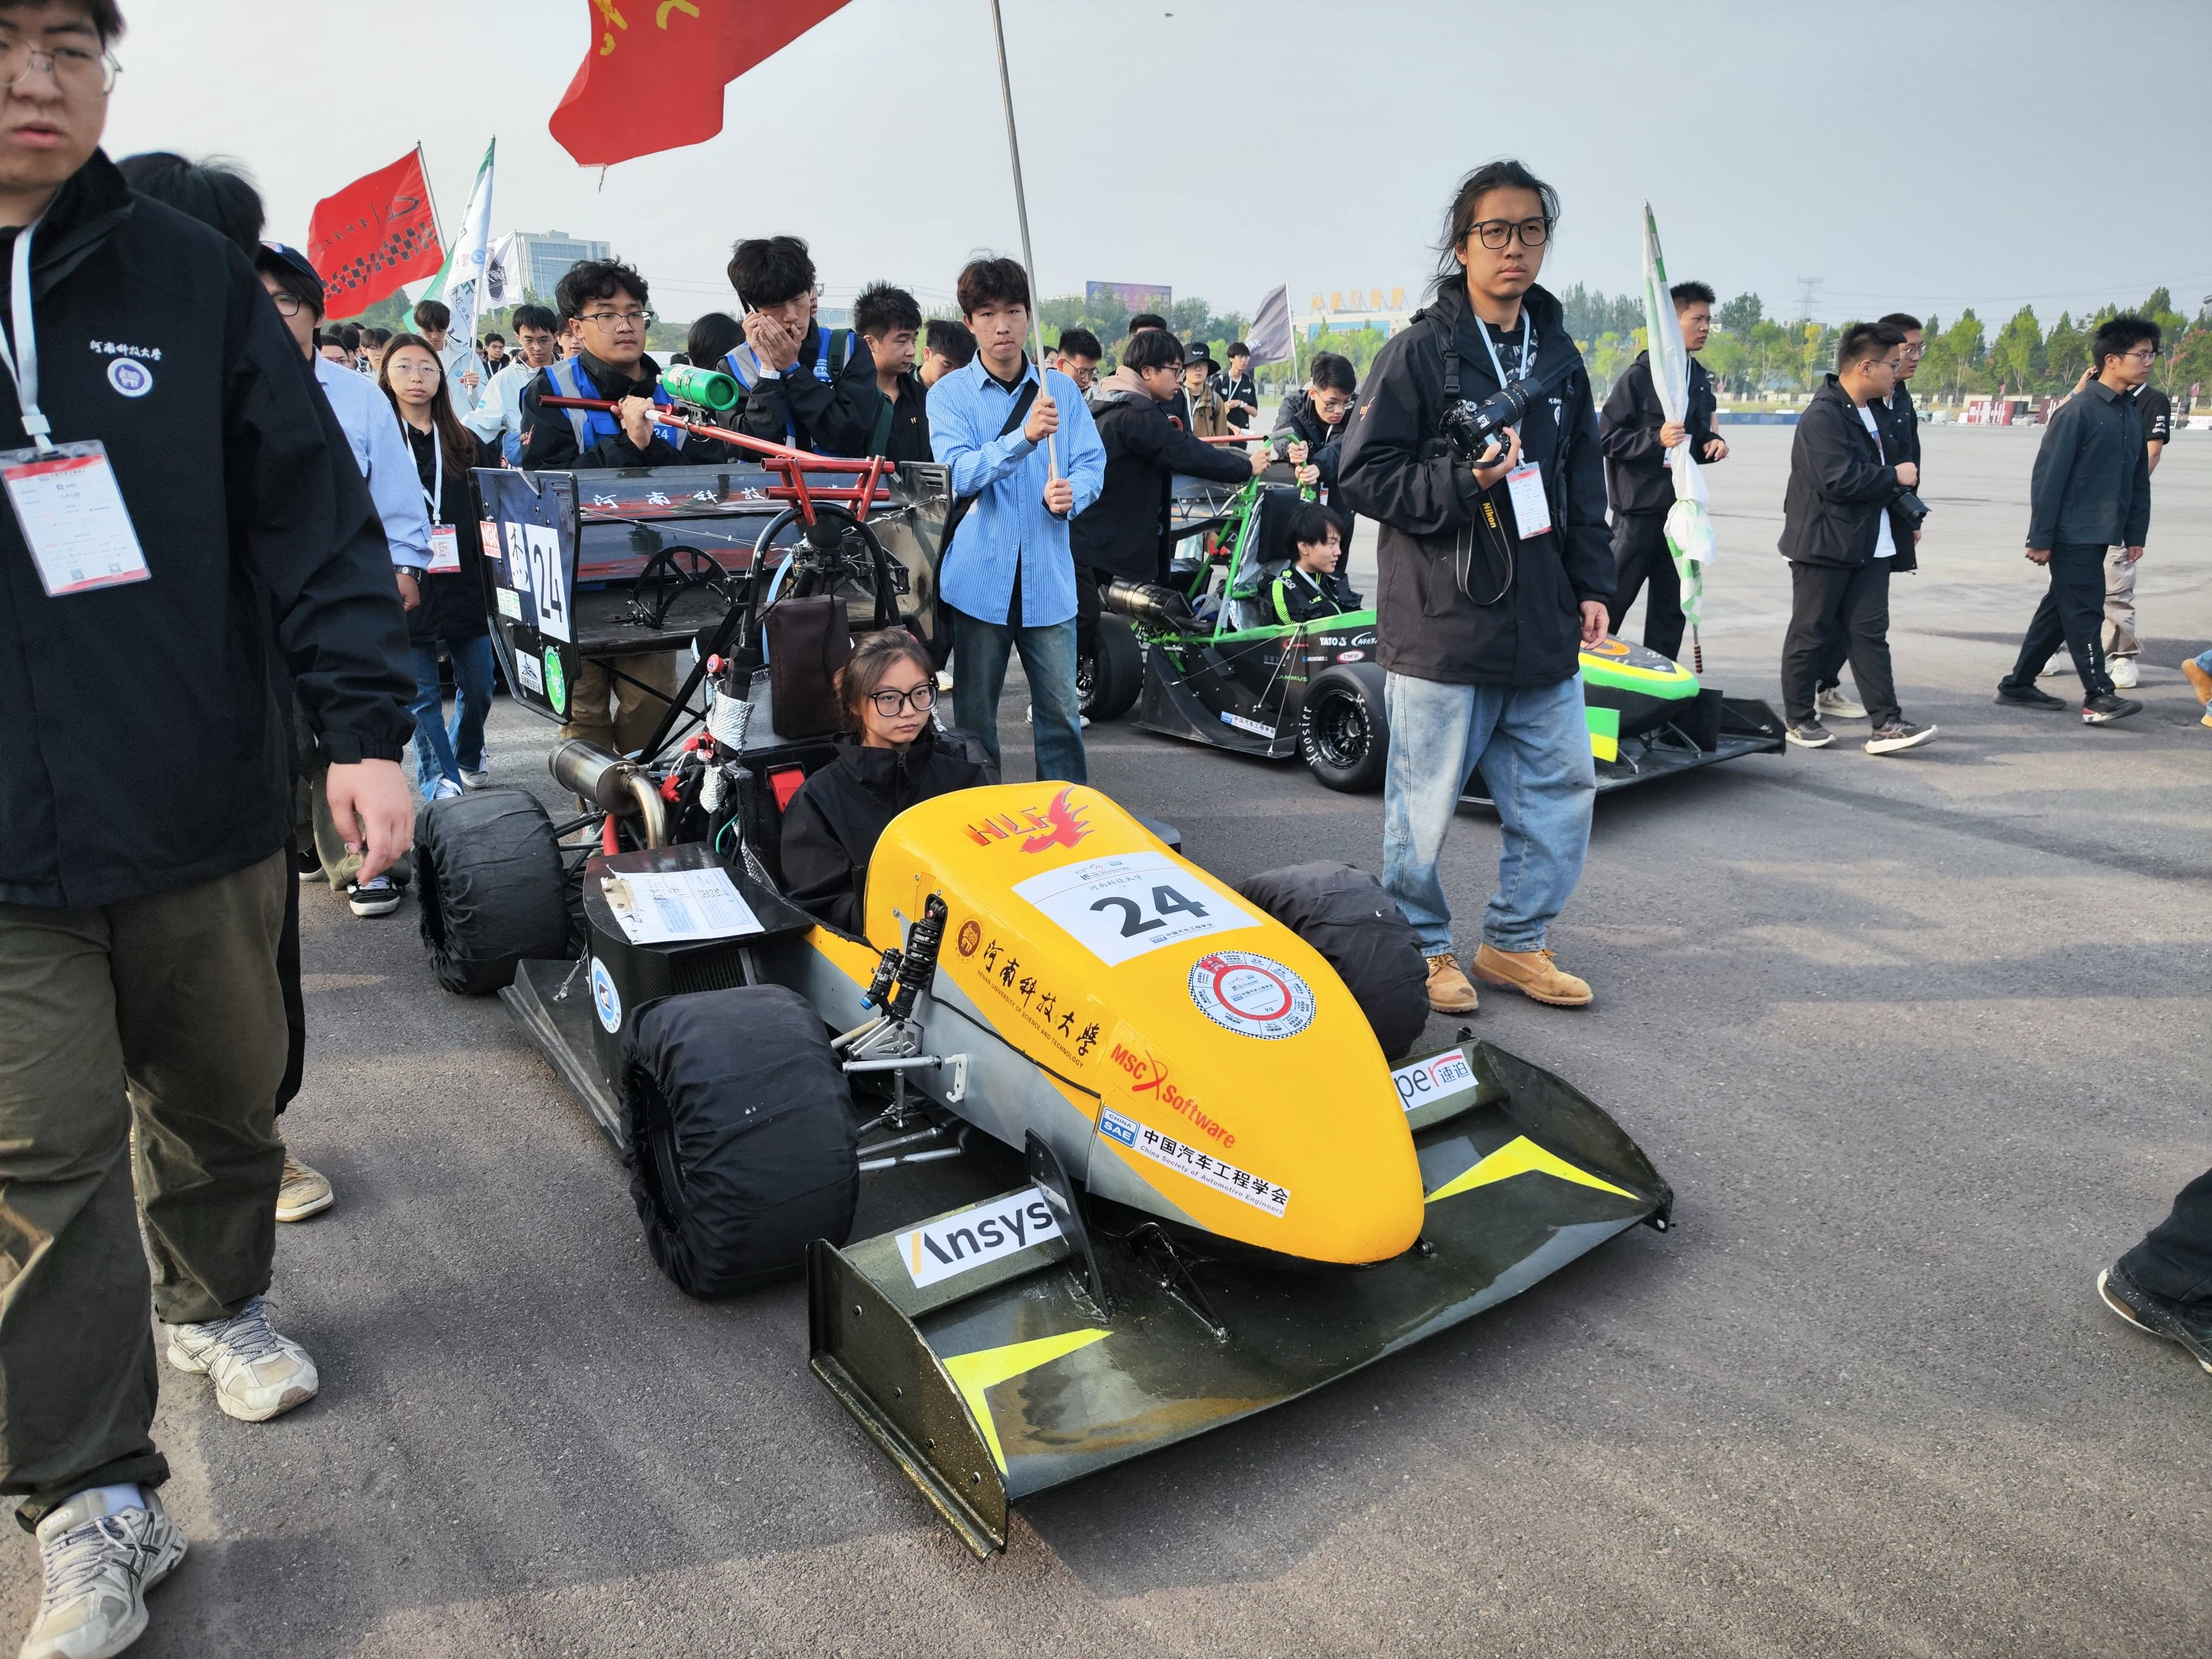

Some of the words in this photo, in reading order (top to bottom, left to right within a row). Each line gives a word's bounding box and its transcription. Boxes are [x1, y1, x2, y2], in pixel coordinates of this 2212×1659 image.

[90, 340, 161, 361] 河南科技大学
[653, 428, 669, 440] 24
[1482, 502, 1496, 528] Nikon
[482, 522, 499, 548] NGK
[534, 544, 563, 623] 24
[1319, 636, 1338, 646] YATO
[1299, 706, 1322, 766] Hoosier
[961, 806, 1050, 846] HLF
[1090, 885, 1210, 938] 24
[1165, 923, 1213, 936] 中国汽车工程学会
[977, 970, 991, 986] HENAN
[991, 983, 1016, 1008] UNIVERSITY
[1015, 1005, 1022, 1013] OF
[1022, 1011, 1041, 1031] SCIENCE
[1040, 1029, 1051, 1041] AND
[1051, 1038, 1084, 1068] TECHNOLOGY
[1110, 1043, 1147, 1080] MSC
[1103, 1121, 1132, 1141] SAE
[1109, 1114, 1132, 1129] CHINA
[1162, 1084, 1236, 1149] Software
[1141, 1145, 1160, 1158] China
[1162, 1156, 1189, 1173] Society
[1201, 1175, 1243, 1197] Automotive
[1245, 1193, 1284, 1215] Engineers
[1143, 1130, 1288, 1205] 中国汽车工程学会
[911, 1202, 1053, 1276] Ansys
